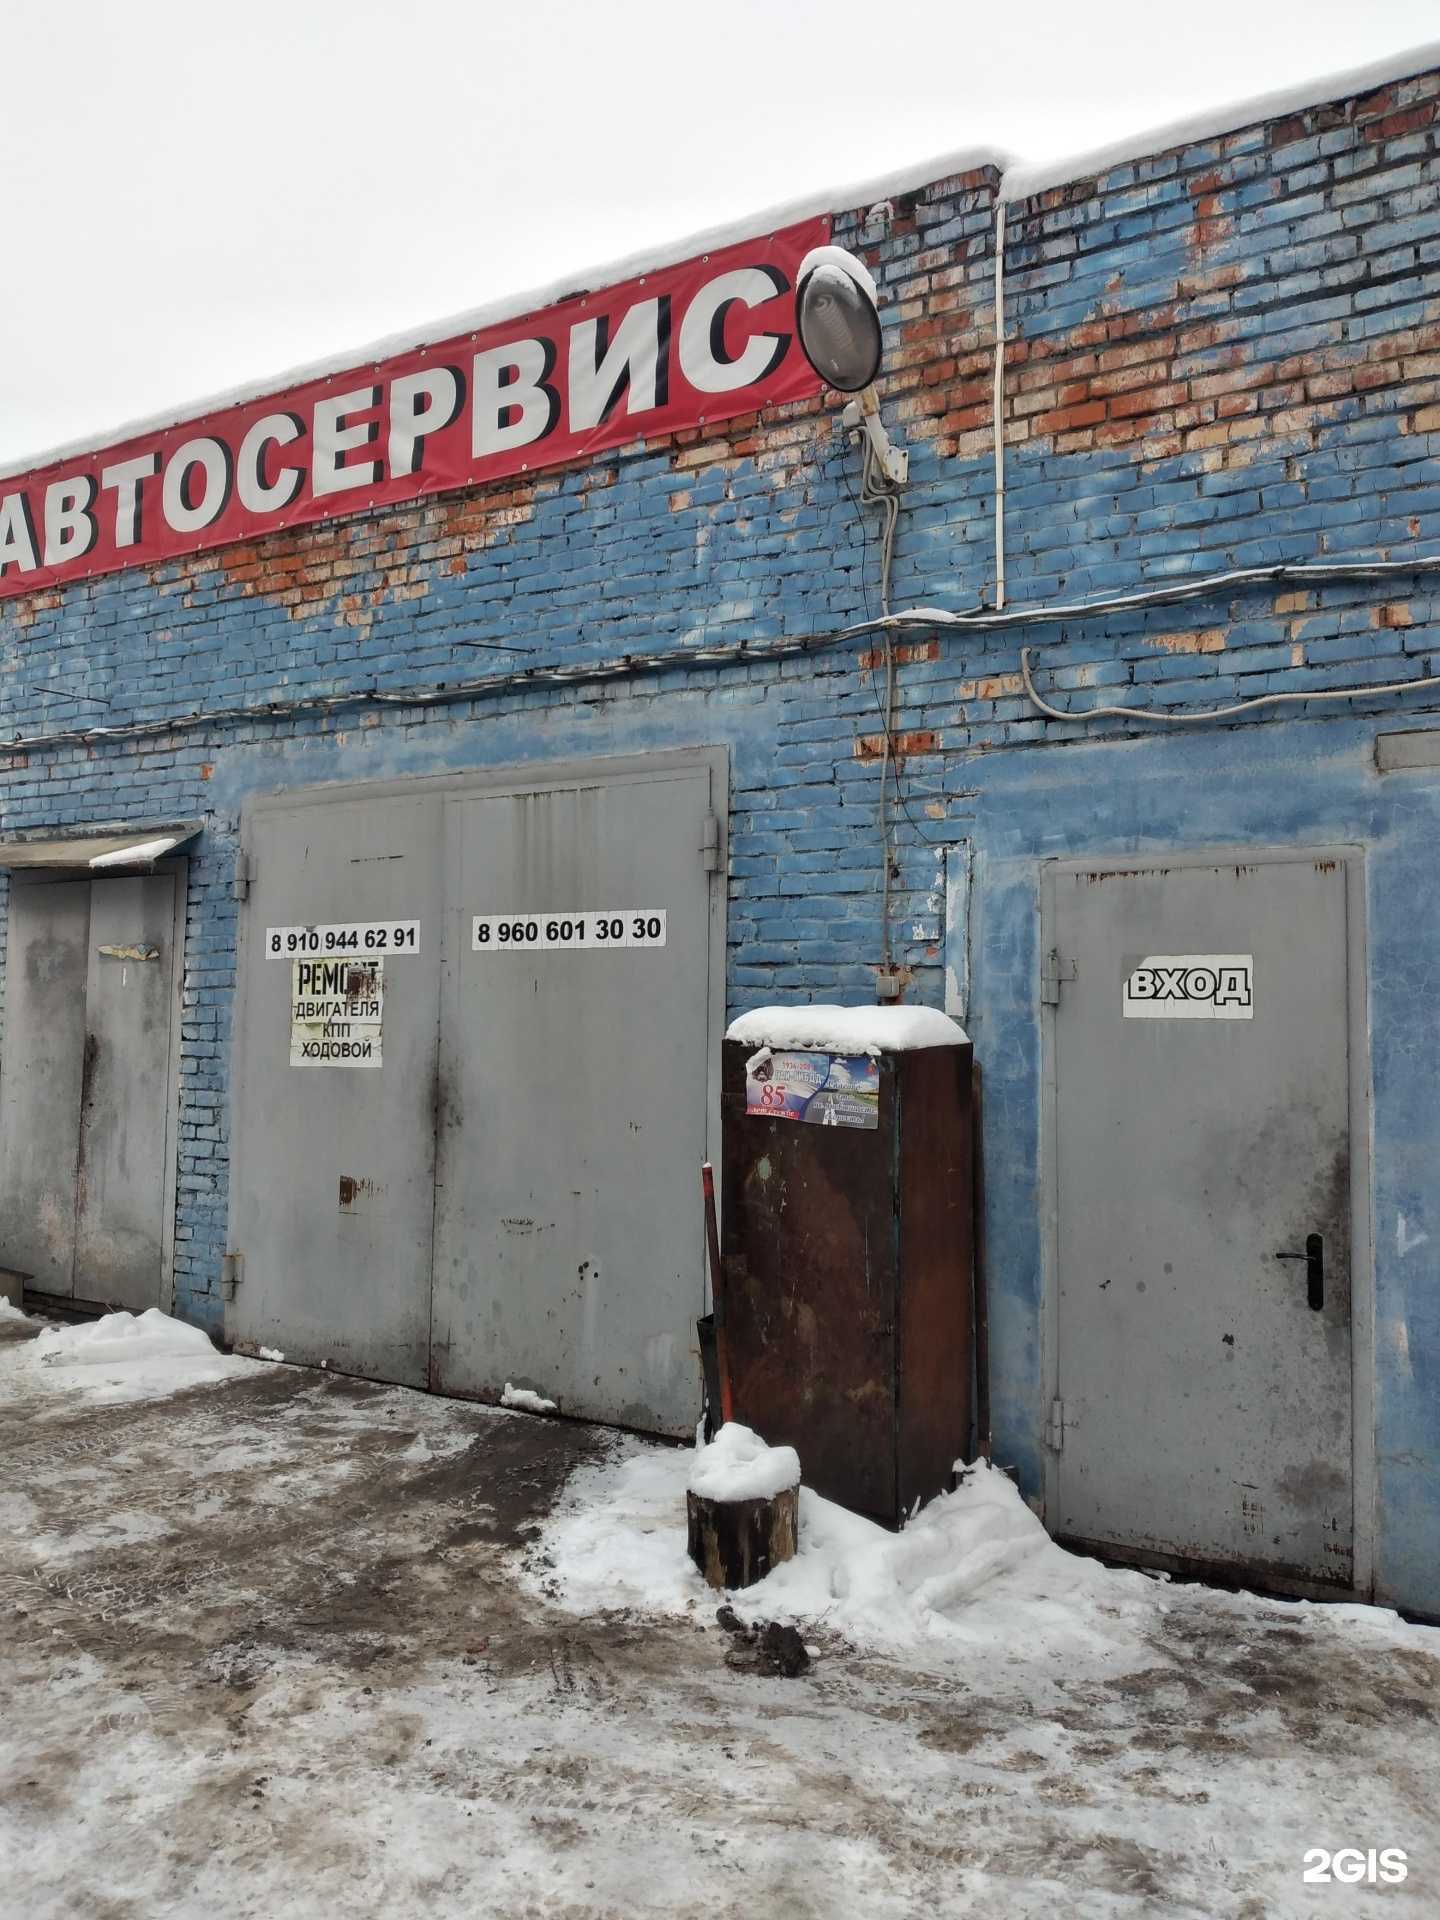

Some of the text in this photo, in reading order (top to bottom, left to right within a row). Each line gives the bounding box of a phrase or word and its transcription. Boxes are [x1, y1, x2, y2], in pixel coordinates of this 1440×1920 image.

[0, 265, 792, 574] АВТОСЕРВИС
[271, 927, 415, 952] 8 910 944 62 91
[478, 917, 661, 943] 8 960 601 30 30
[298, 961, 379, 995] РЕМОТ
[1128, 967, 1251, 1006] ВХОД
[296, 1001, 379, 1019] ДВИГАТЕЛЯ
[322, 1022, 350, 1038] КПП
[301, 1038, 371, 1060] ХОДОВОЙ
[761, 1084, 785, 1106] 85
